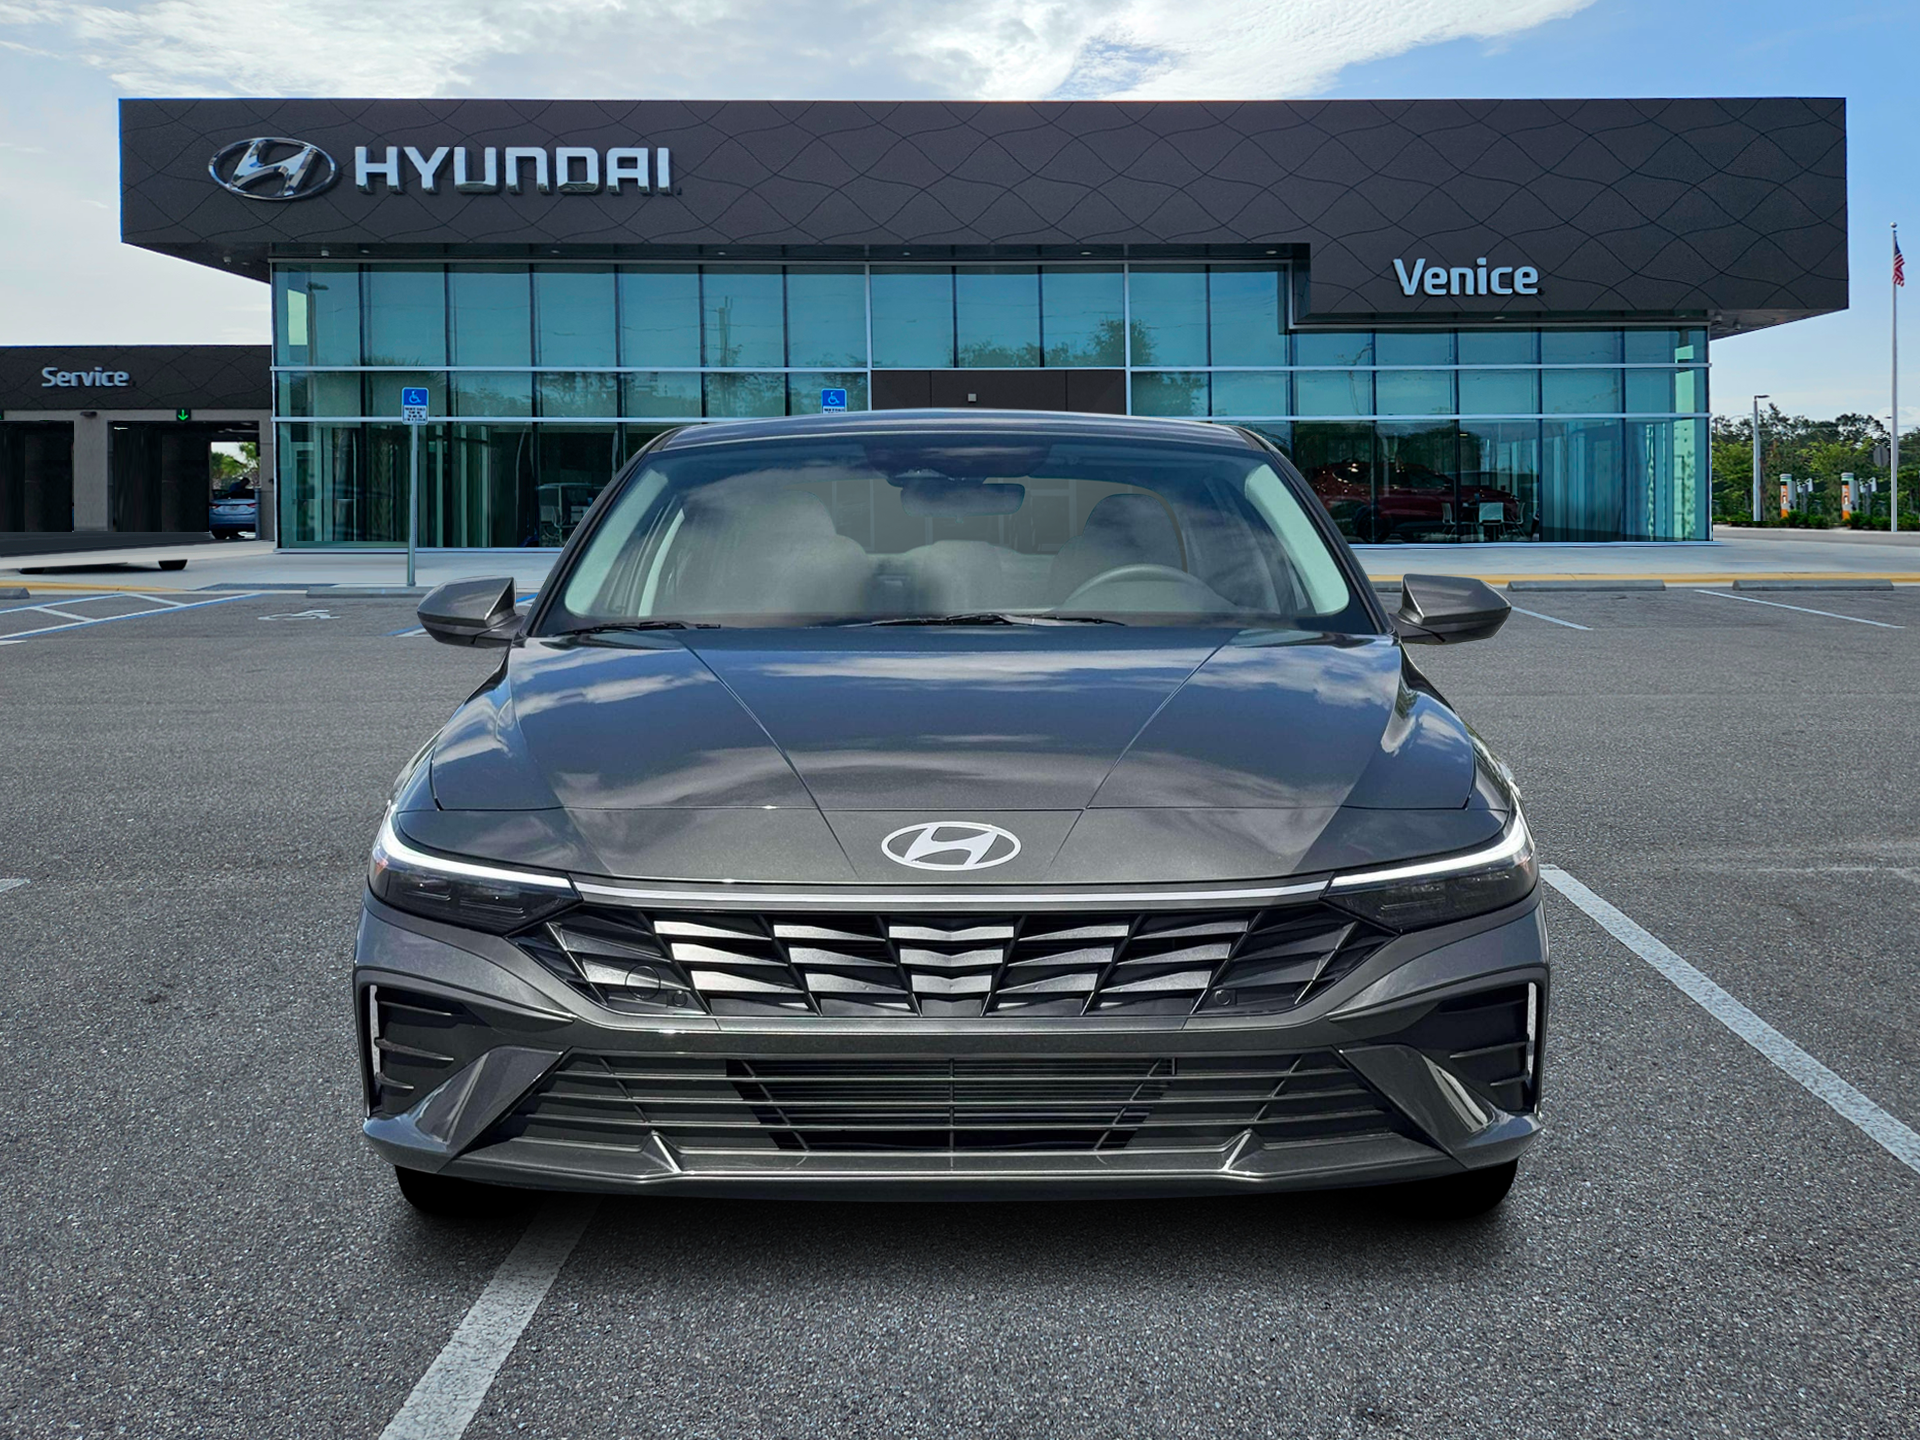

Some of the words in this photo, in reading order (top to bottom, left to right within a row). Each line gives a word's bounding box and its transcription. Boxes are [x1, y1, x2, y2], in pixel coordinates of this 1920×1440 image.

[354, 146, 671, 194] HYUNDAI
[1393, 257, 1539, 295] Venice
[41, 367, 130, 387] Service
